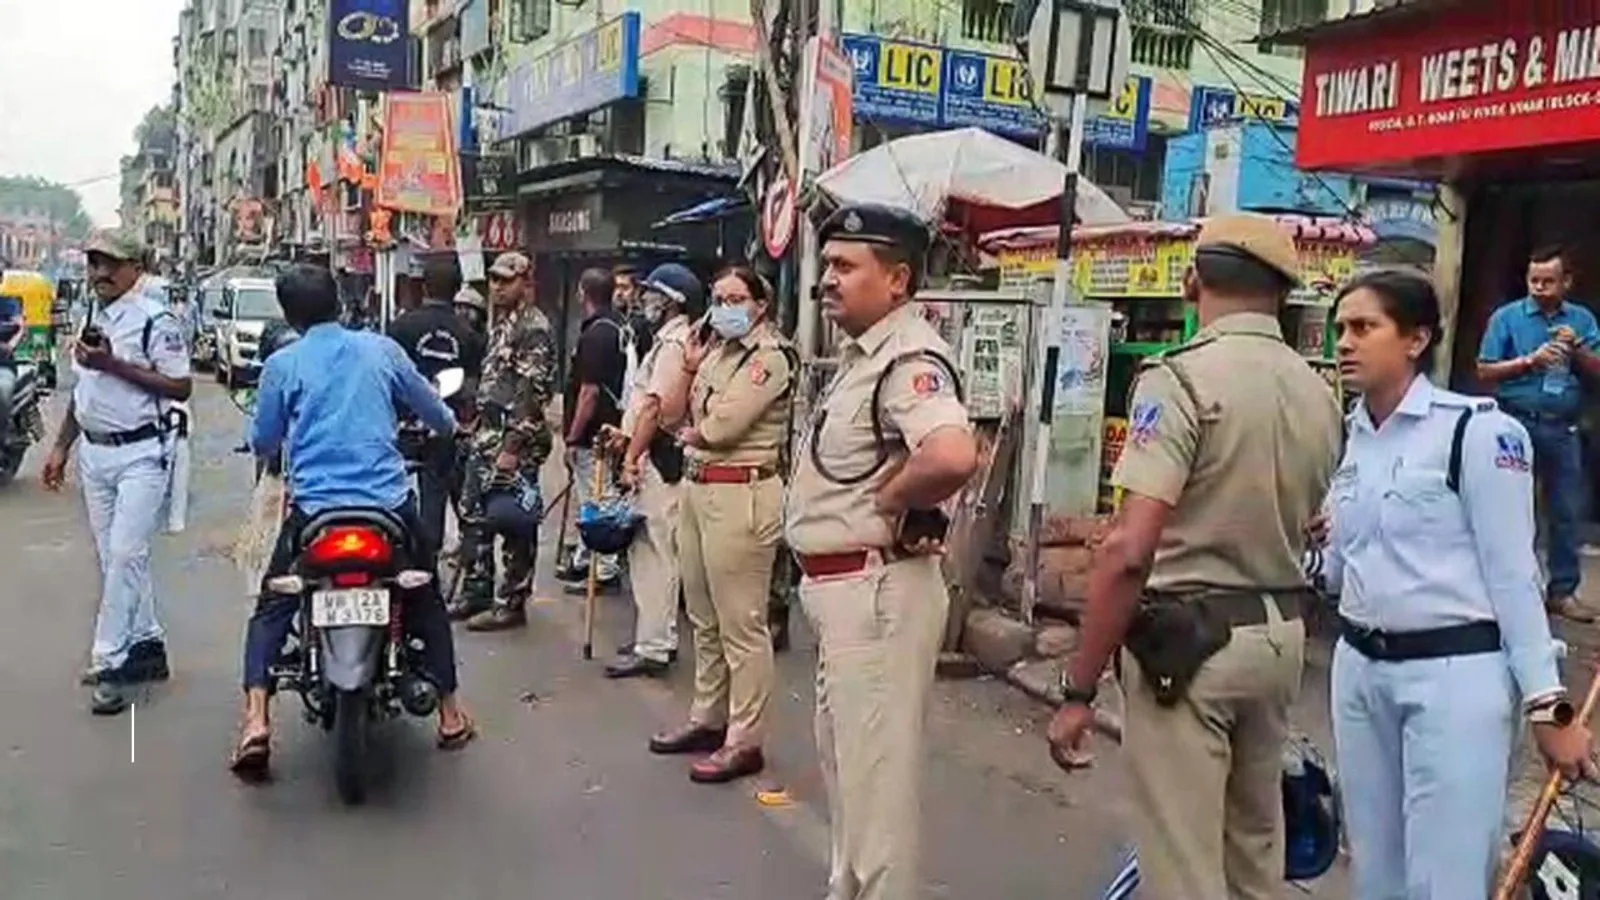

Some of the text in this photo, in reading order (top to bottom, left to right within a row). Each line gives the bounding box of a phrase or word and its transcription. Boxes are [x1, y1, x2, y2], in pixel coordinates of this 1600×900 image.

[886, 48, 933, 87] LIC
[992, 64, 1030, 99] LIC
[1316, 60, 1399, 117] TIWARI
[1420, 37, 1517, 103] WEETS
[1523, 35, 1547, 88] &
